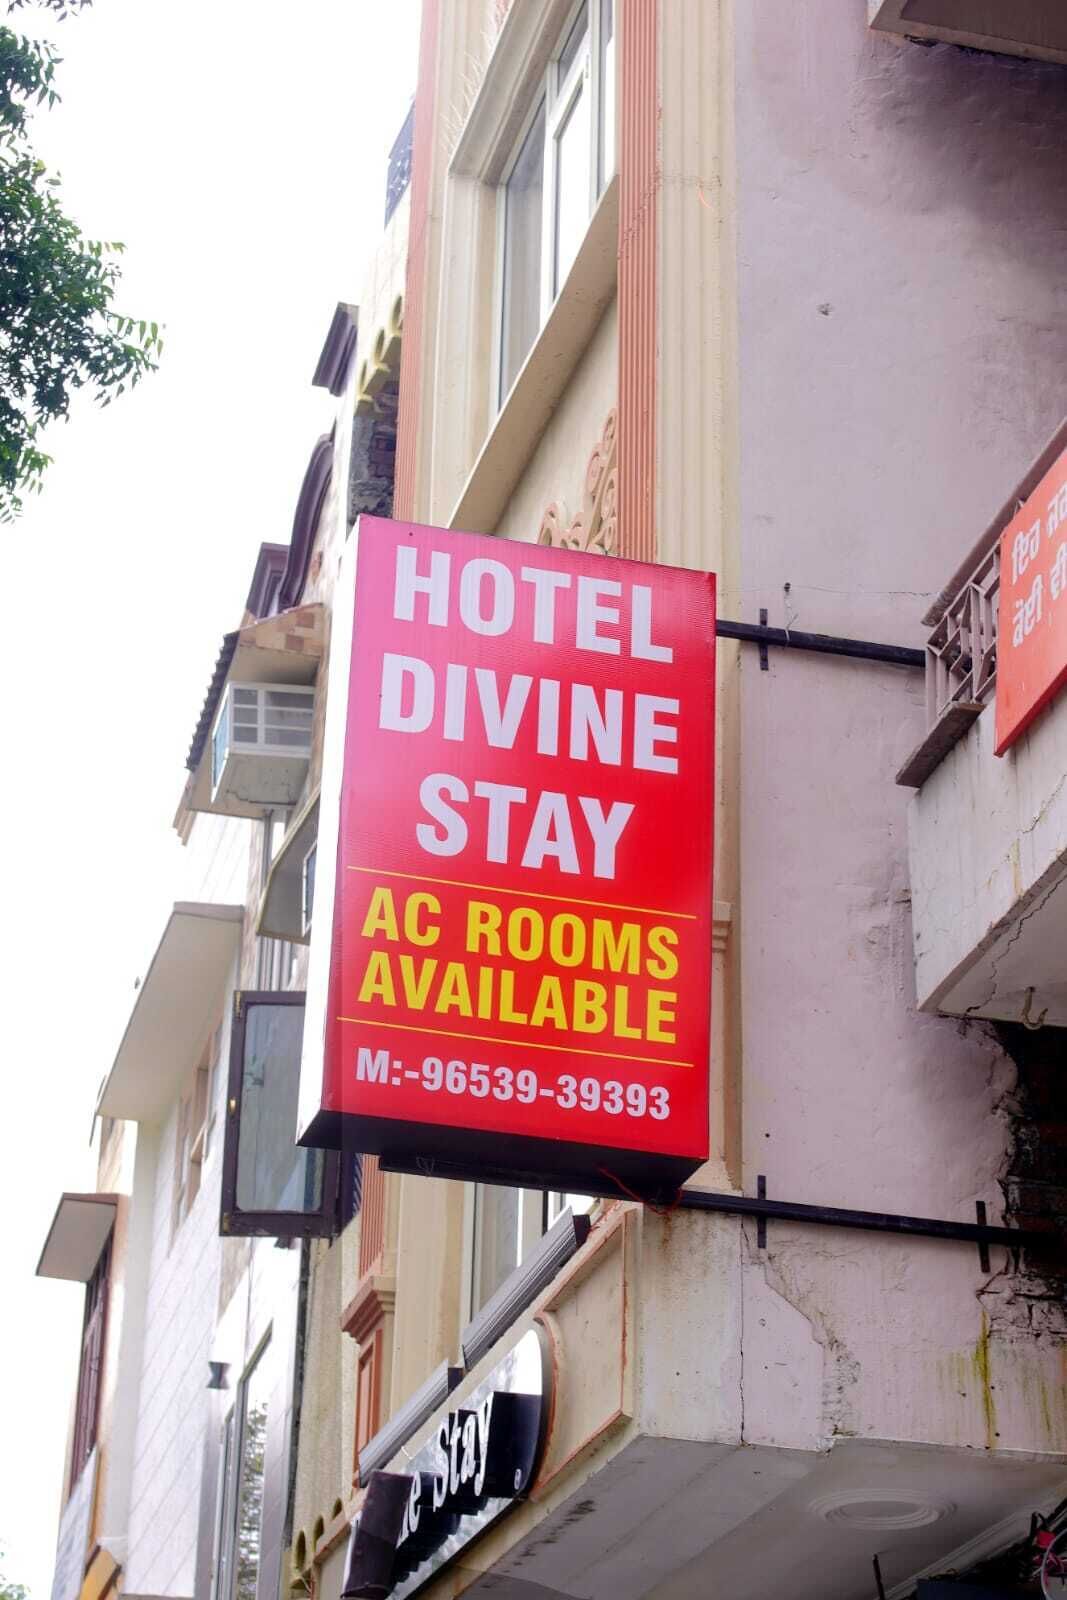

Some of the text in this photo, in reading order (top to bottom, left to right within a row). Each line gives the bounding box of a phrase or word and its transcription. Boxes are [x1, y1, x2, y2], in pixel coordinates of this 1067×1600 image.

[393, 545, 674, 664] HOTEL
[379, 652, 680, 775] DIVINE
[416, 773, 635, 880] STAY
[361, 887, 680, 980] AC ROOMS
[358, 951, 677, 1044] AVAILABLE
[355, 1047, 671, 1121] M:-96539-39393
[433, 1391, 494, 1513] Stay
